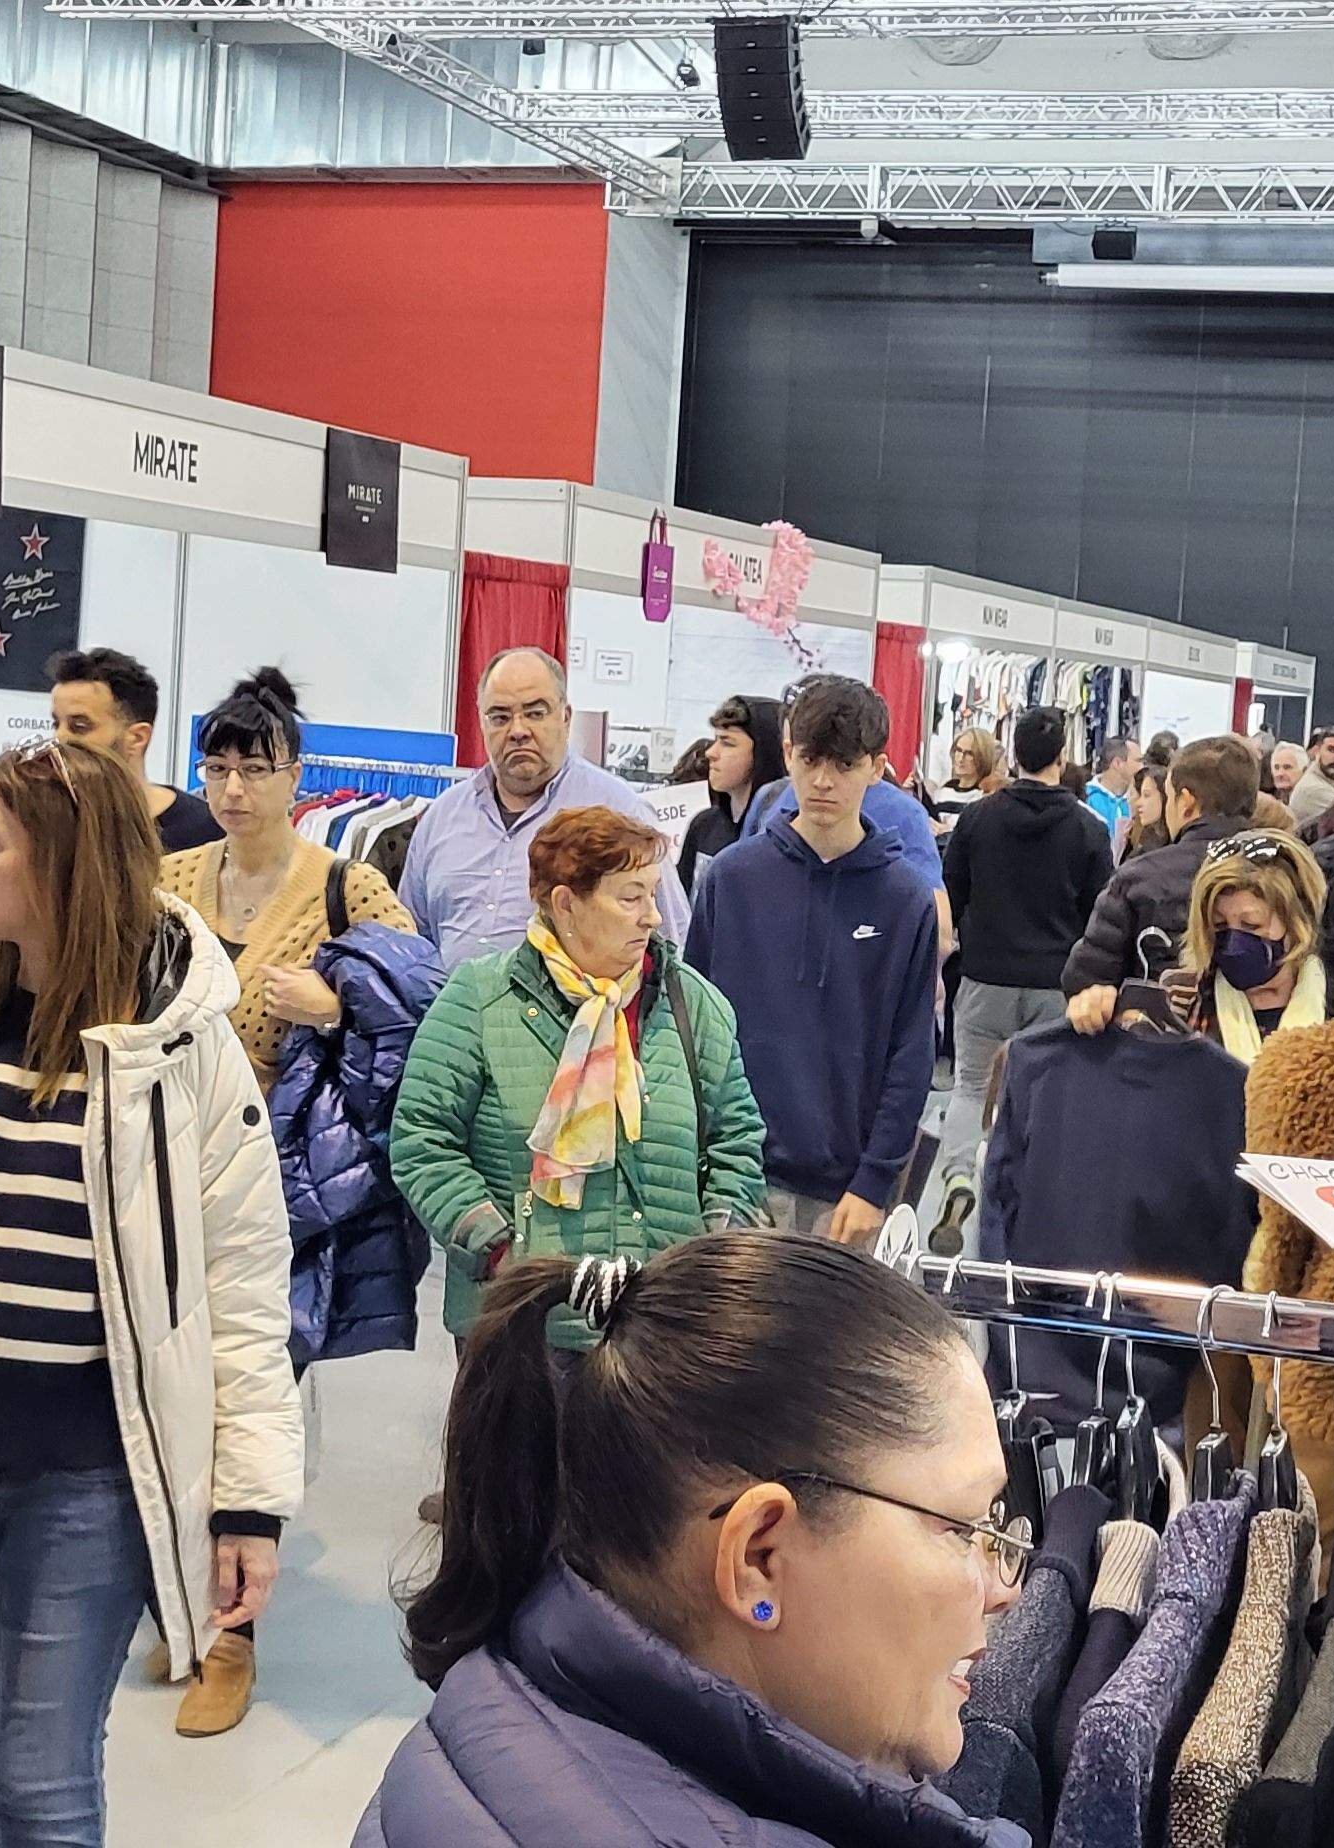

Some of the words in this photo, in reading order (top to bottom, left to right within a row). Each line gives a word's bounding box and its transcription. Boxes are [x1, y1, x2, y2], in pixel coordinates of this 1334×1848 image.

[133, 431, 199, 483] MIRATE
[347, 482, 383, 505] MIRATE
[657, 804, 687, 821] ESDE
